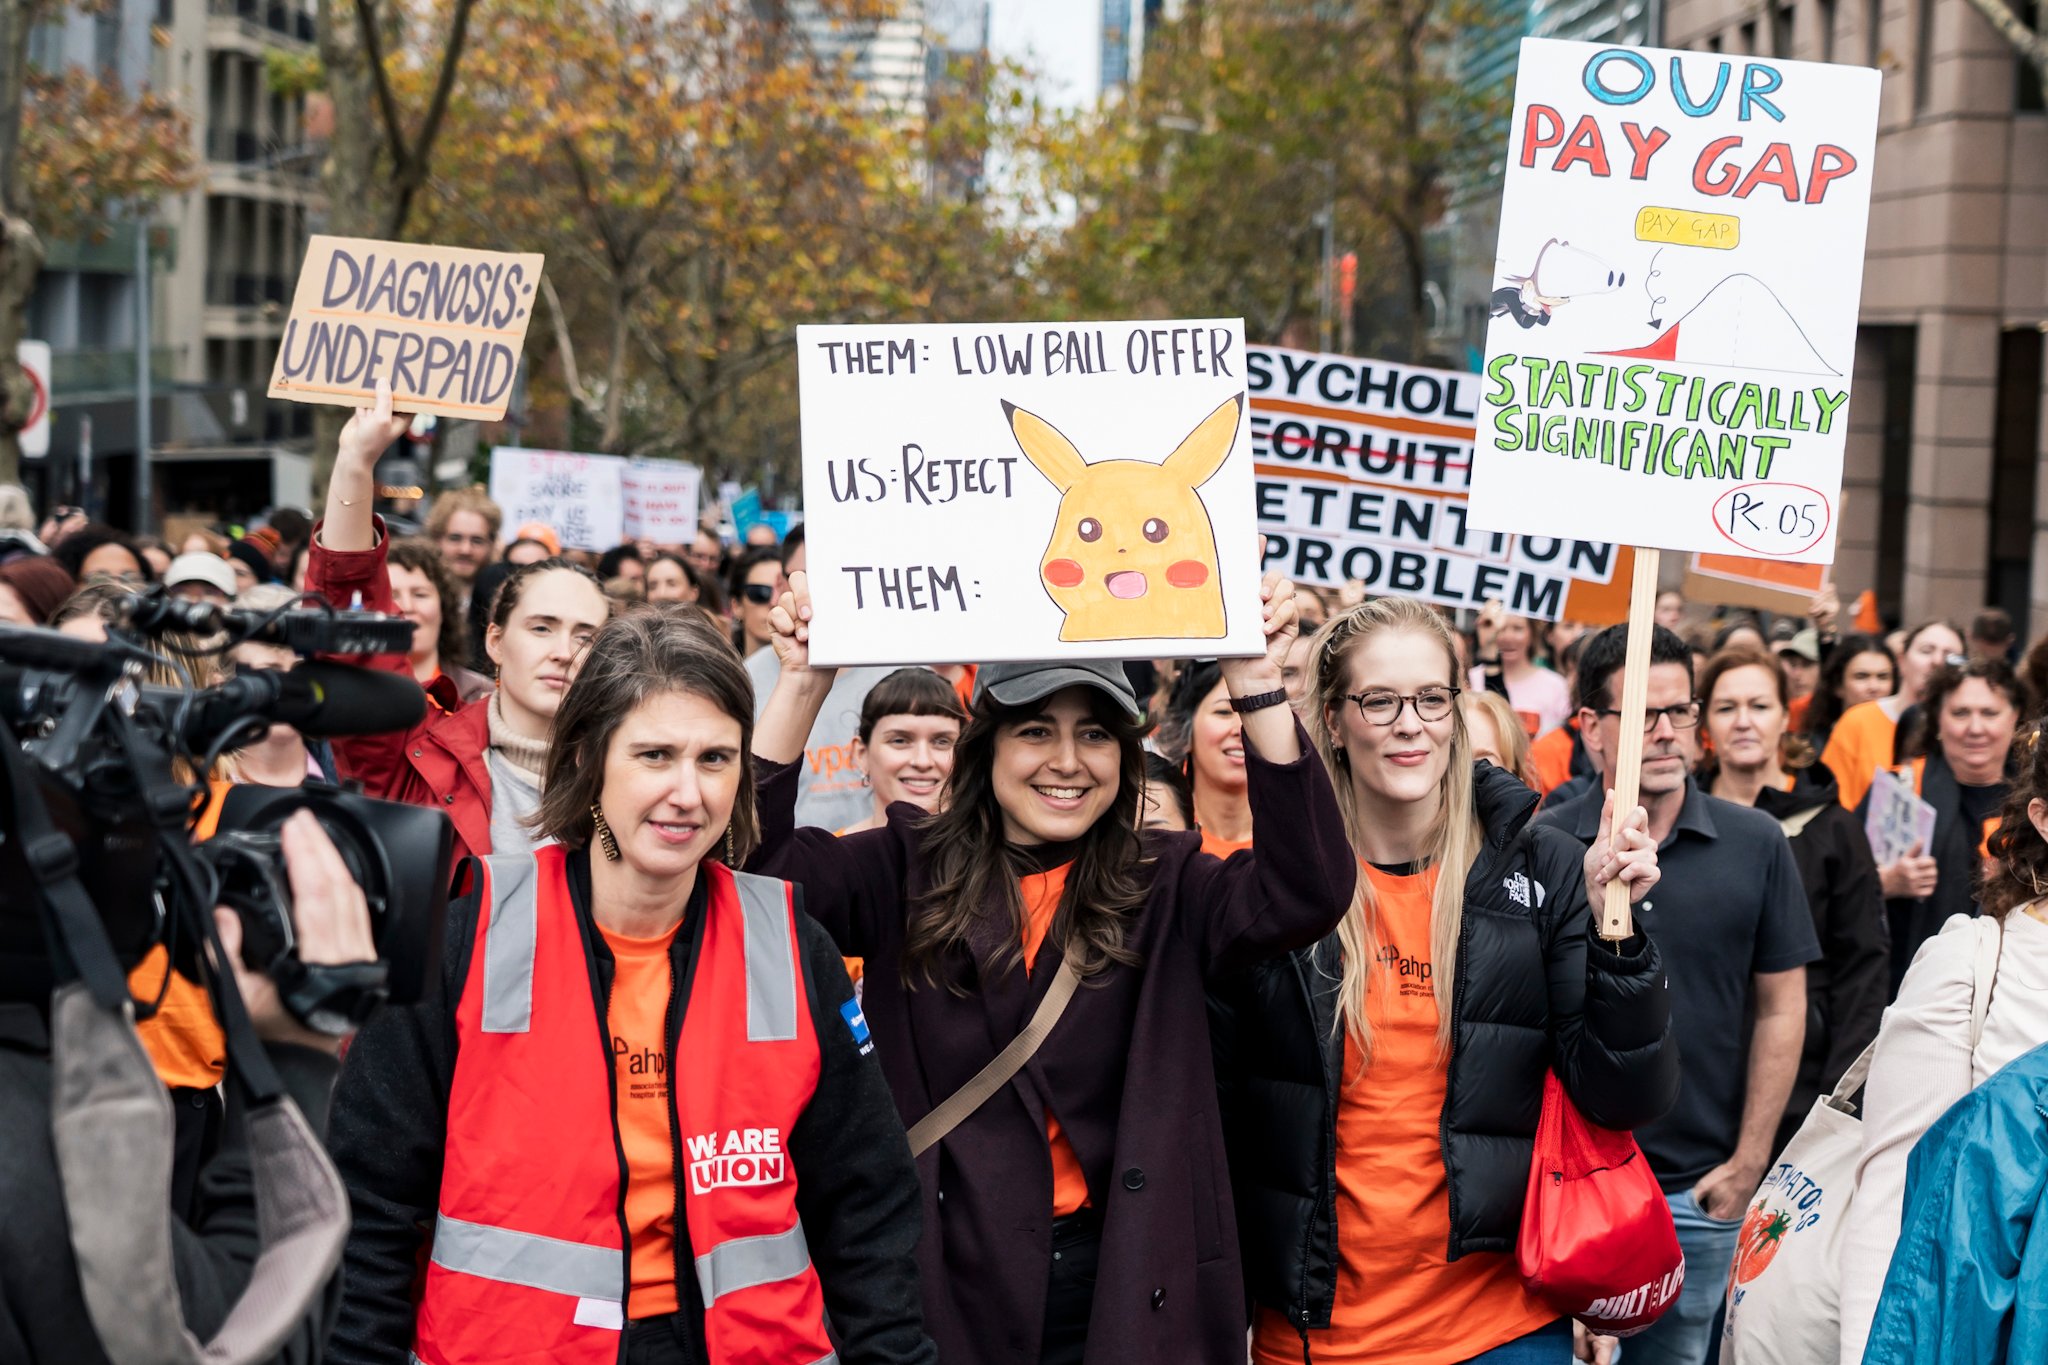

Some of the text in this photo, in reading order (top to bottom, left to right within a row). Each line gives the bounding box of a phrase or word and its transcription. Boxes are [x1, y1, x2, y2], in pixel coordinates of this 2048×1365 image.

[1582, 49, 1786, 123] OUR
[1520, 104, 1857, 204] PAY GAP
[1641, 212, 1731, 241] PAY GAP
[322, 249, 532, 329] DIAGNOSIS:
[283, 318, 514, 405] UNDERPAID
[818, 338, 930, 375] THEM:
[1126, 327, 1234, 378] OFFER
[1485, 353, 1849, 434] STATISTICALLY
[1494, 405, 1791, 480] SIGNIFICANT
[842, 565, 982, 612] THEM:
[1261, 533, 1563, 618] PROBLEM
[722, 1128, 780, 1154] ARE
[1581, 1282, 1652, 1320] BUILT
